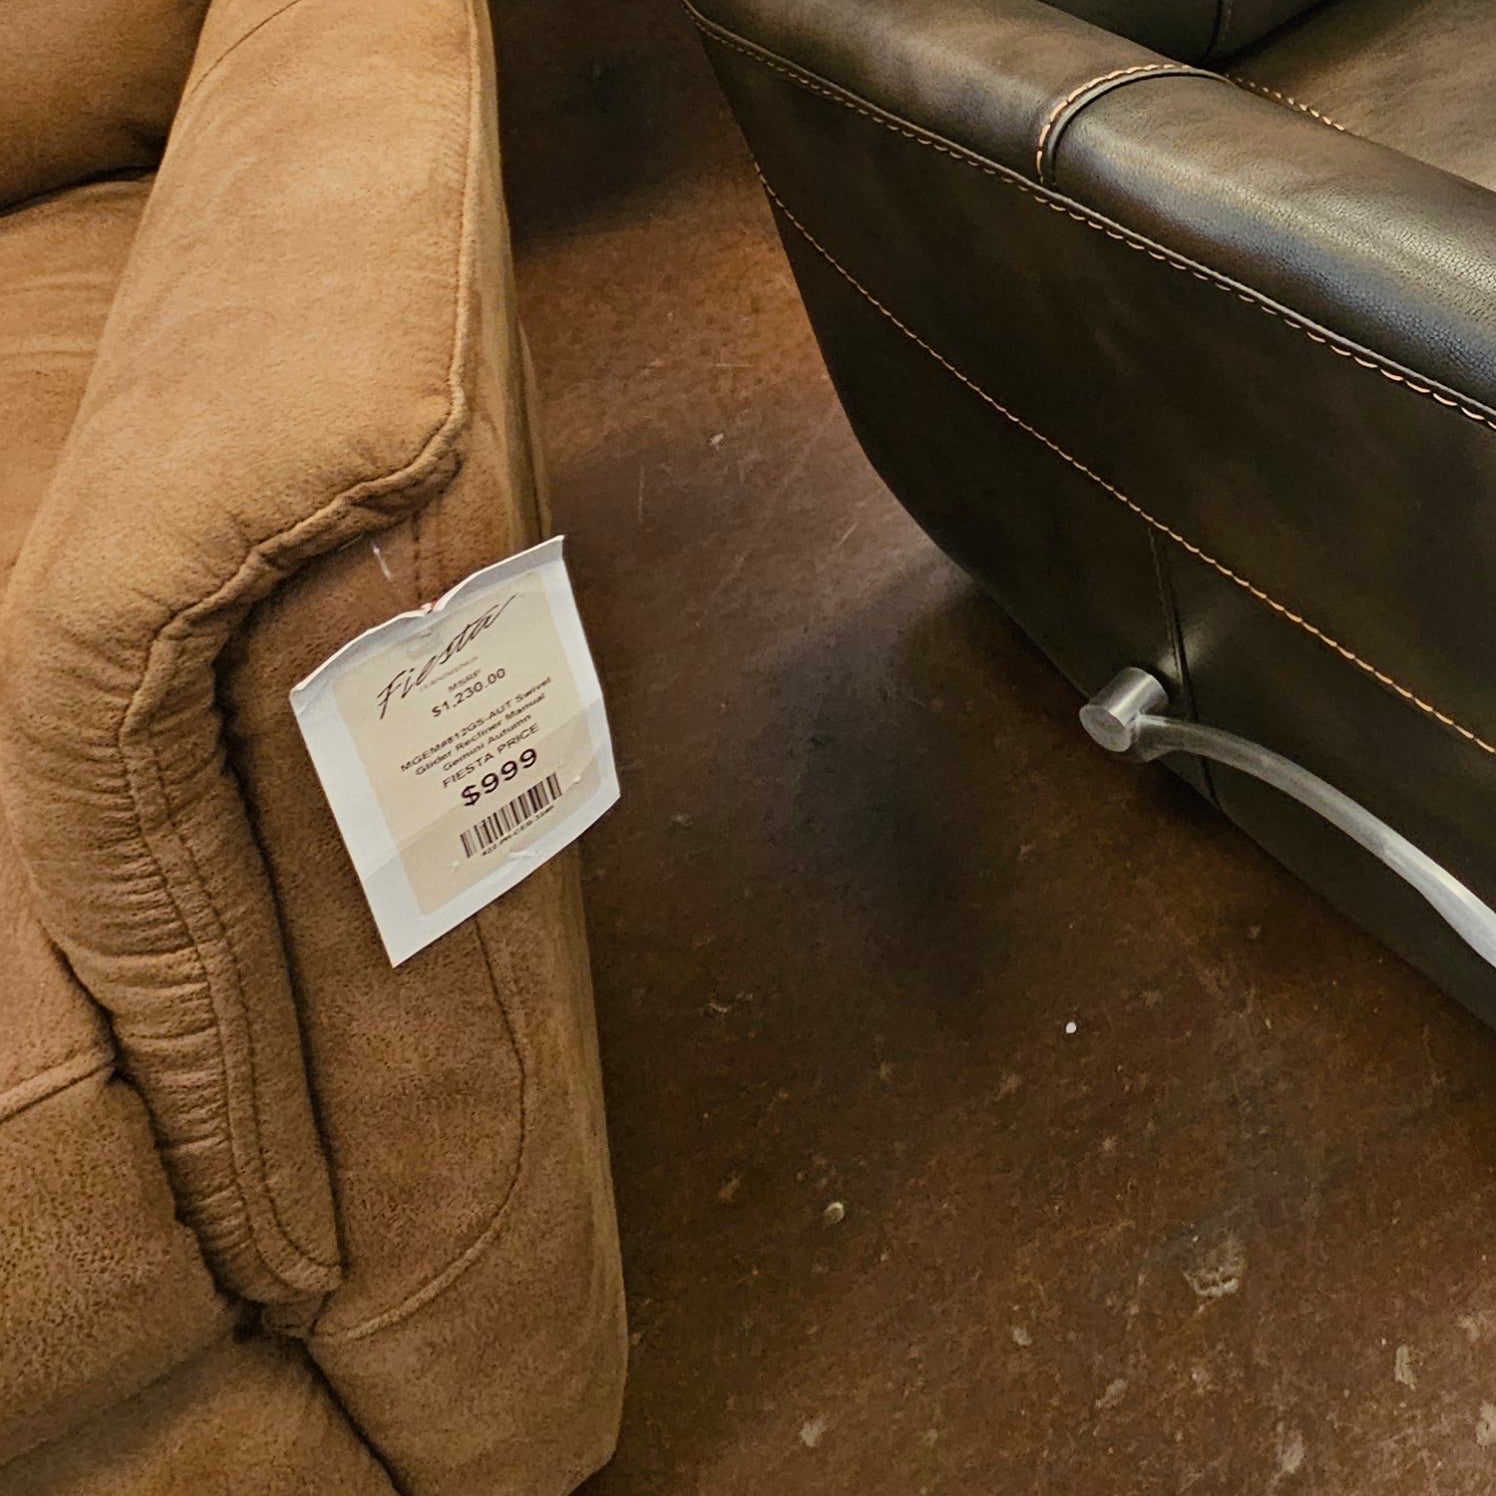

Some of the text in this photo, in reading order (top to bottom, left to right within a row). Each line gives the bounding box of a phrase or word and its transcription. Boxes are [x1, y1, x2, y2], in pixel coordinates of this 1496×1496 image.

[376, 593, 518, 721] Fiesta
[447, 668, 482, 693] MSRP
[431, 667, 507, 718] $1,230.00
[515, 677, 552, 704] Swivel
[414, 692, 546, 776] Glider Recliner Manual
[441, 722, 541, 789] FIESTA PRICE
[442, 714, 532, 772] Gemini Autumn
[460, 747, 538, 808] $999
